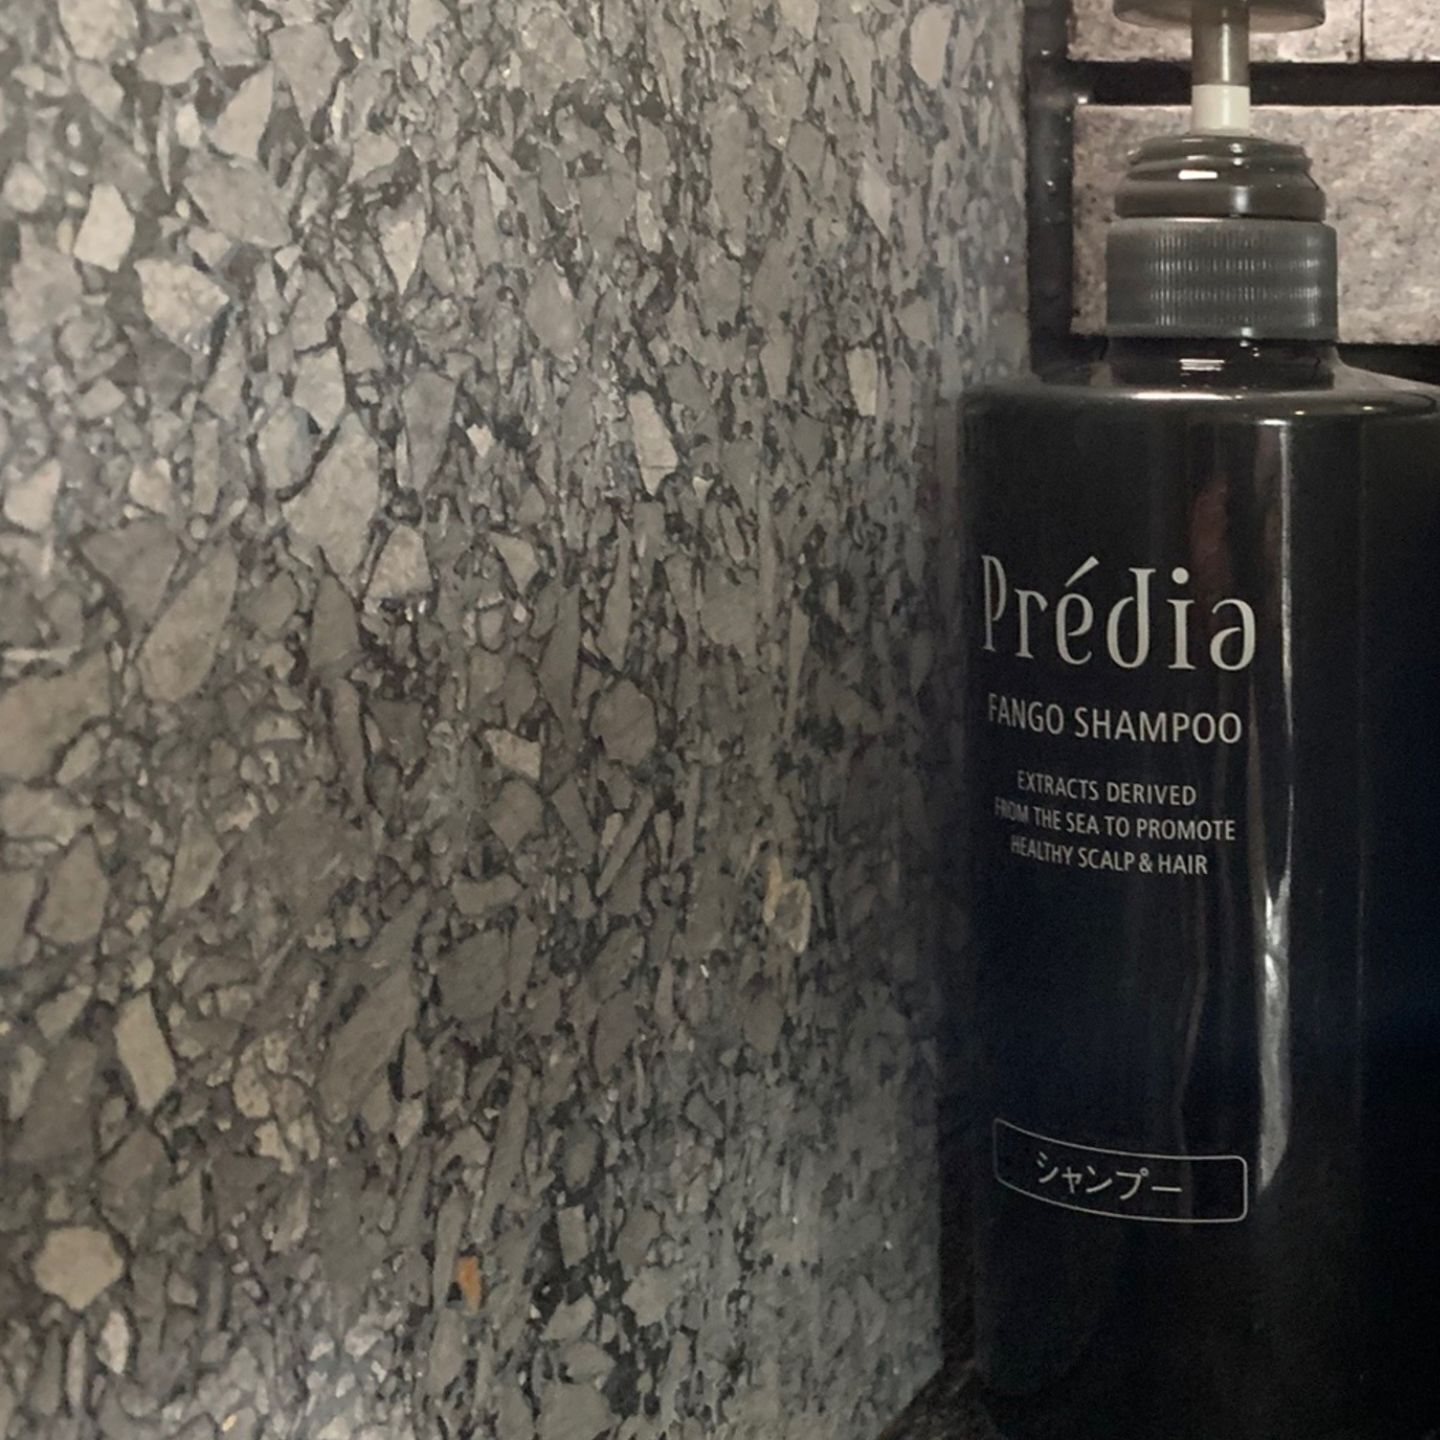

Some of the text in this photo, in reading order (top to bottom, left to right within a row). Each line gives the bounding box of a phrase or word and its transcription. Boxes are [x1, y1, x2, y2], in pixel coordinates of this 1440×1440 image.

[981, 555, 1255, 671] Prédia
[988, 693, 1241, 743] FANGO SHAMPOO
[1017, 770, 1196, 806] EXTRACTS DERIVED
[995, 797, 1235, 841] FROM THE SEA TO PROMOTE
[1011, 835, 1207, 874] HEALTHY SCALP & HAIR
[1037, 1152, 1182, 1200] シャンプー
